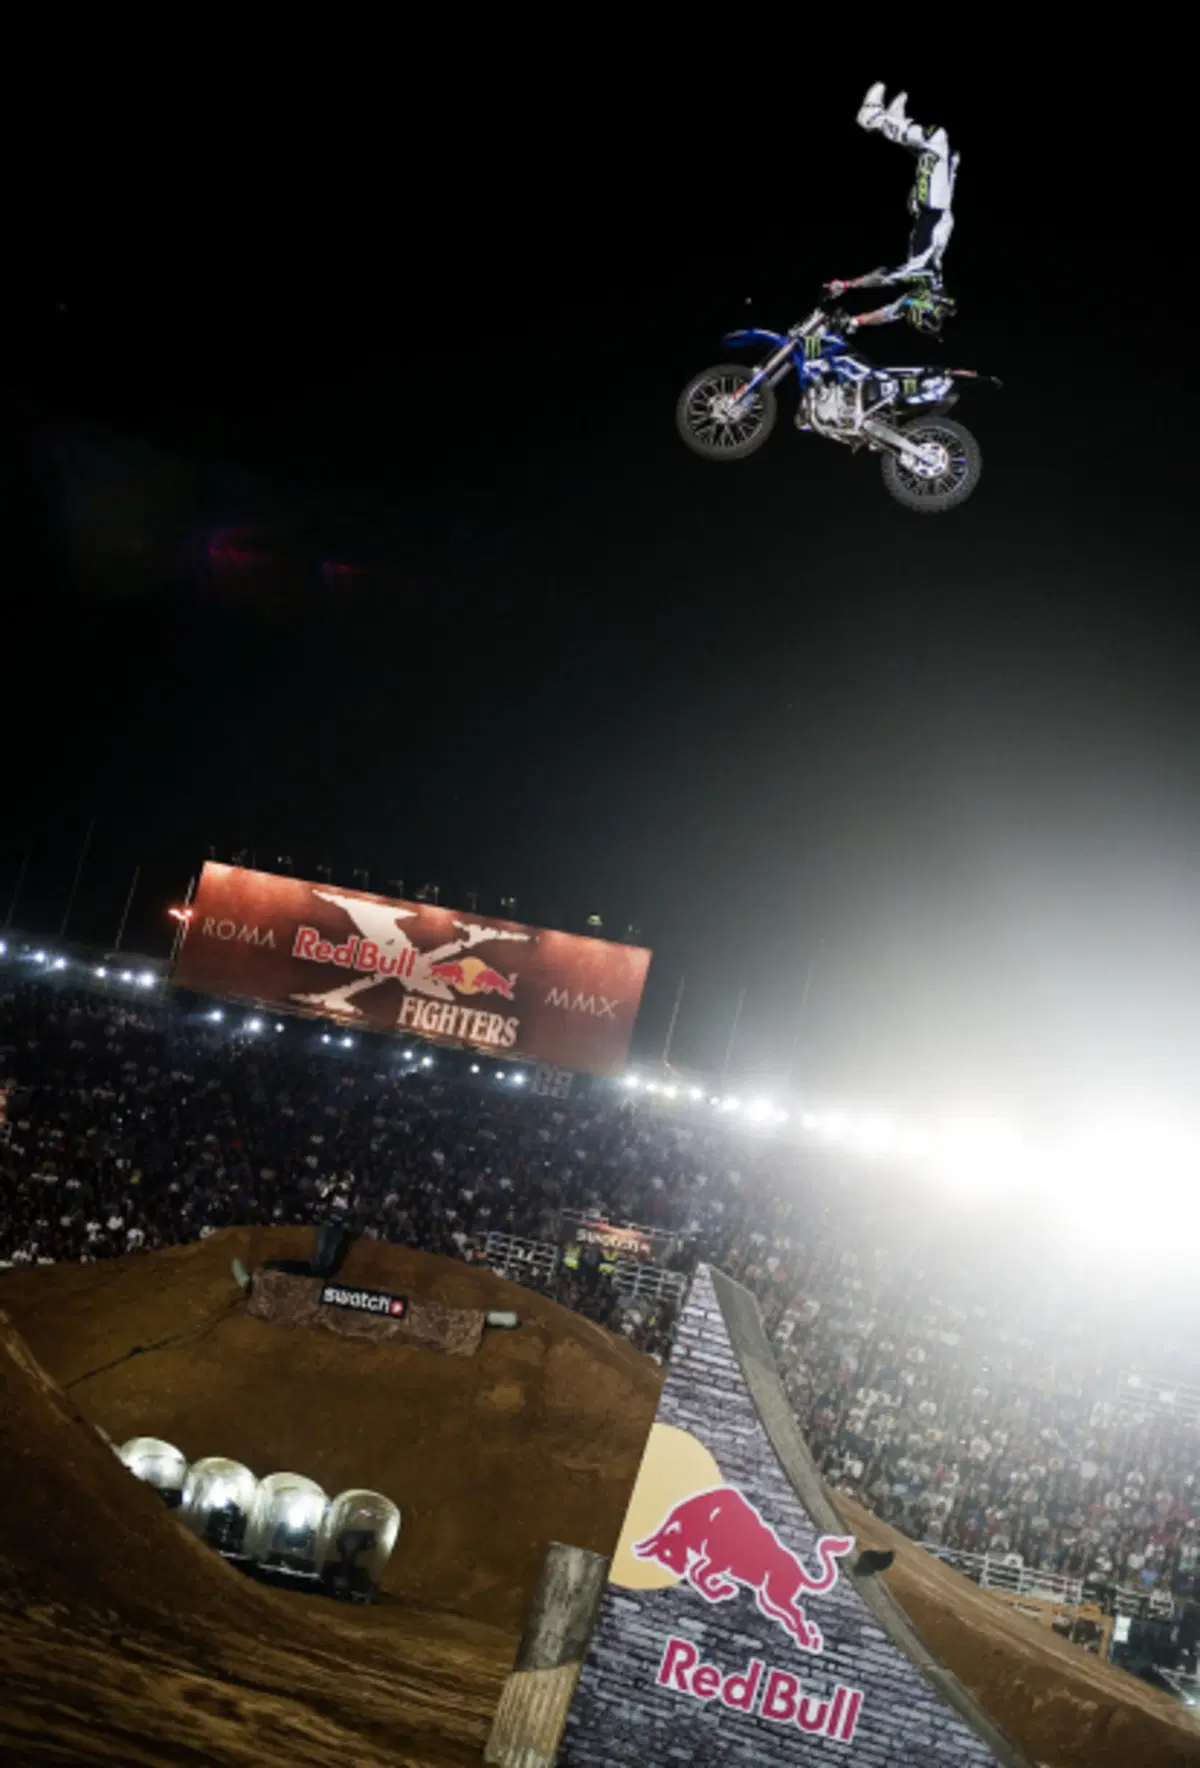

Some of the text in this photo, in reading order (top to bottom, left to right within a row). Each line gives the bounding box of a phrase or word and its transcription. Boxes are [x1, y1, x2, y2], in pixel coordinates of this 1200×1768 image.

[202, 916, 276, 949] ROMA
[293, 926, 417, 977] Red Bull
[397, 996, 519, 1047] FIGHTERS
[545, 987, 620, 1019] MMX
[323, 1287, 391, 1313] swatch
[658, 1638, 863, 1741] Red Bull
